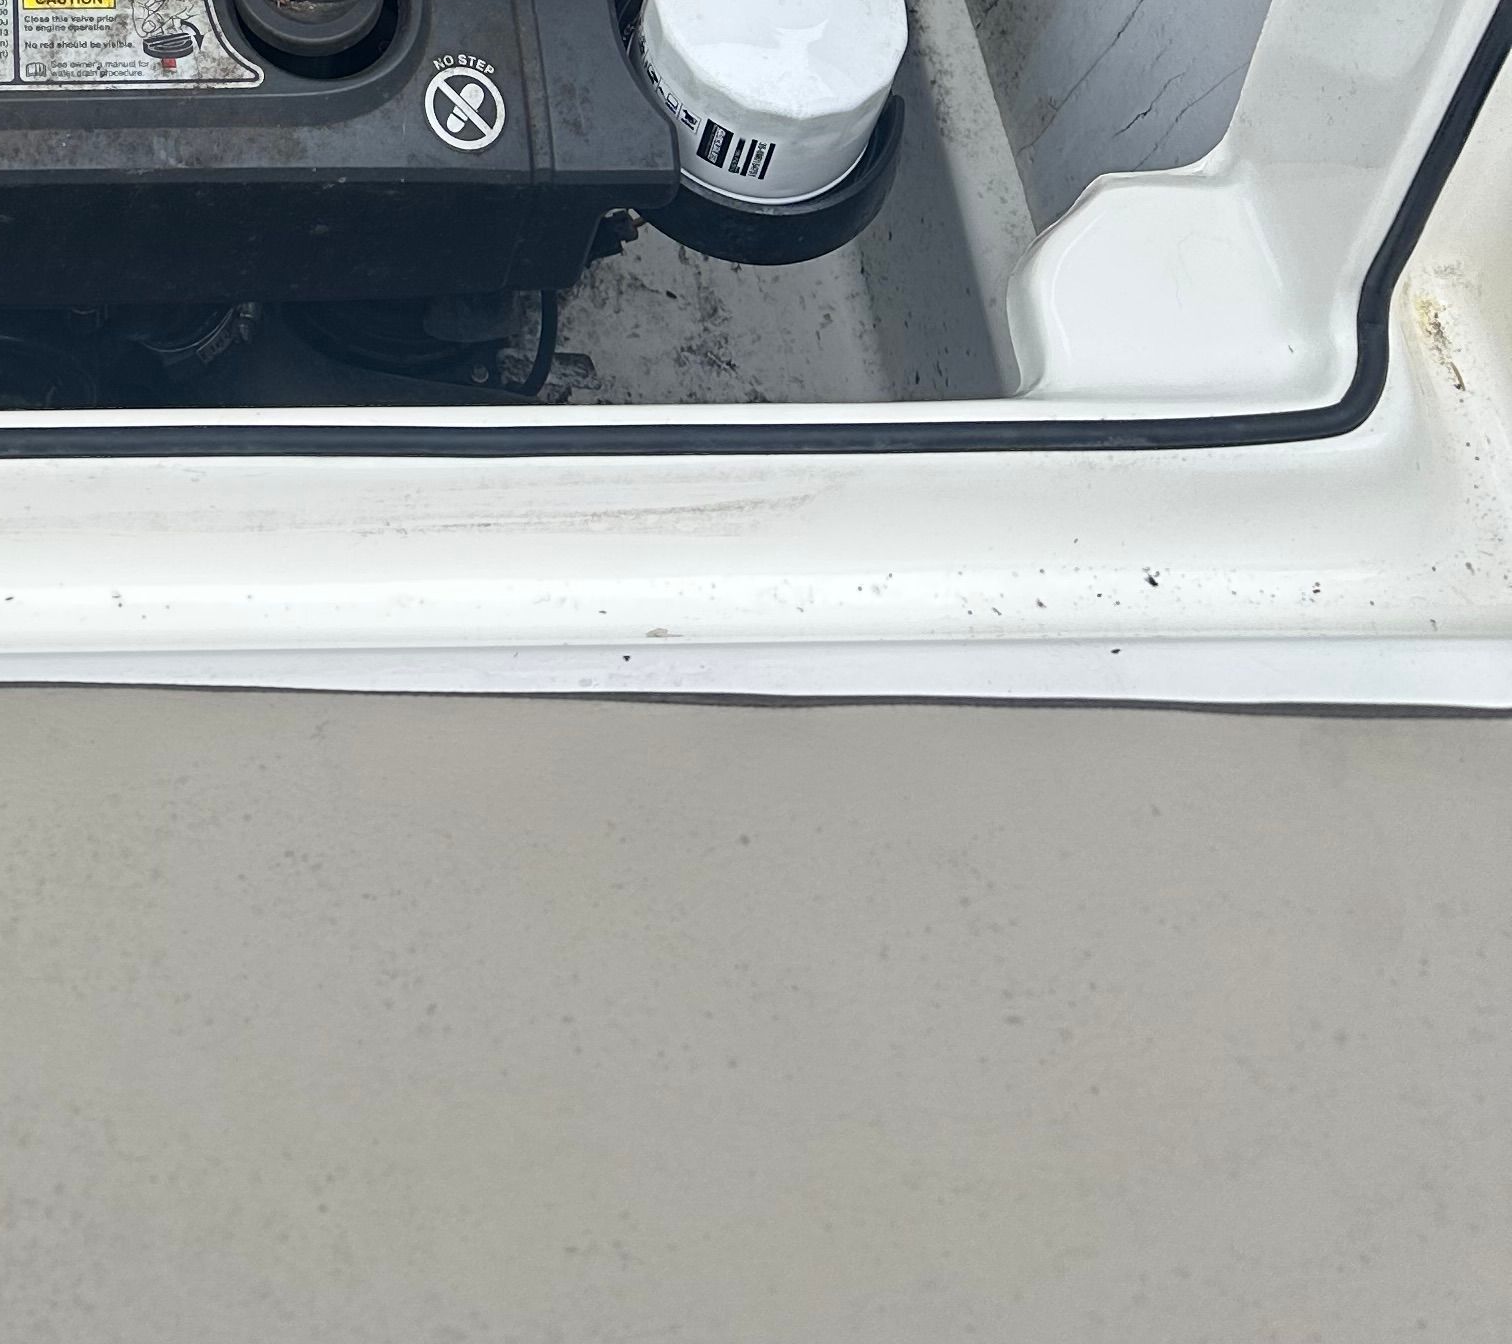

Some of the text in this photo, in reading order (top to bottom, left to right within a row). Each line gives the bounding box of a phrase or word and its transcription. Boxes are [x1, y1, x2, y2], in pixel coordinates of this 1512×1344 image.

[97, 15, 117, 24] prior
[68, 24, 112, 32] operation.
[24, 41, 37, 49] No
[103, 41, 135, 49] visible.
[433, 54, 495, 74] NO STEP
